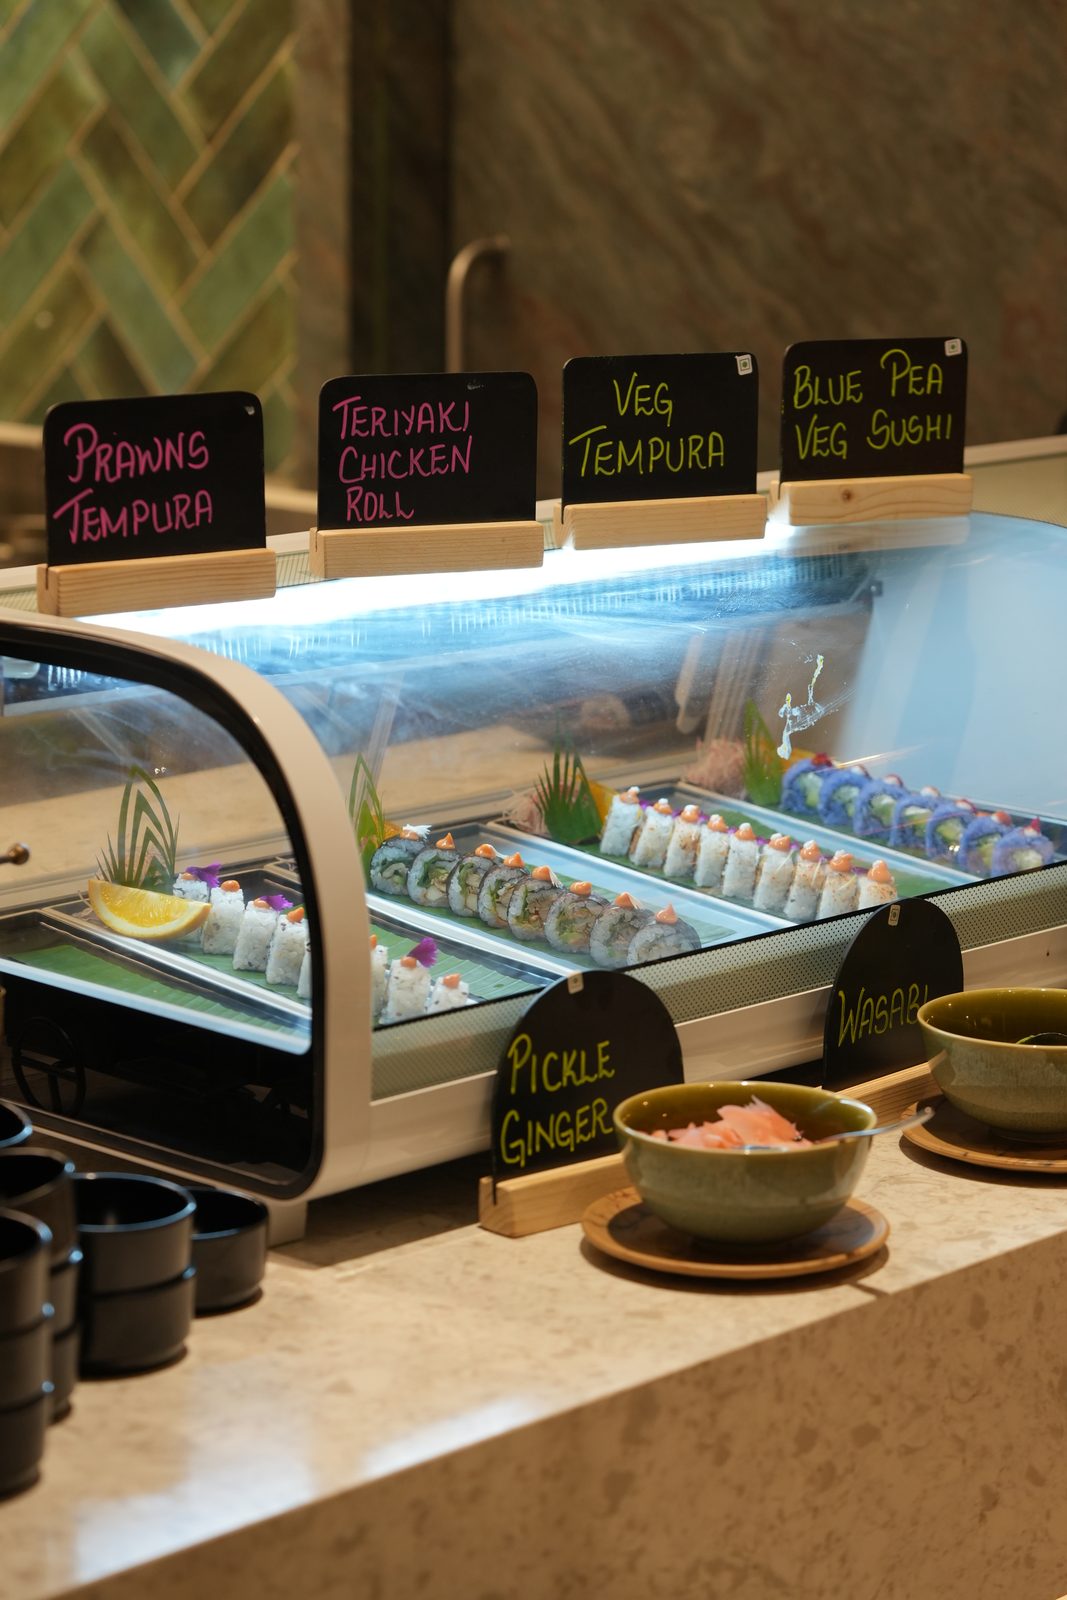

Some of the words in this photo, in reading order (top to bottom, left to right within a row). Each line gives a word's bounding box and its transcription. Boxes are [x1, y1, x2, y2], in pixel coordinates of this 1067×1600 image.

[613, 371, 673, 428] VEG
[793, 365, 863, 409] BLUE
[880, 348, 943, 397] PEA
[332, 395, 472, 442] TERIYAKI
[795, 414, 847, 460] VEG
[866, 408, 952, 450] SUSHI
[63, 422, 209, 483] PRAWNS
[338, 435, 473, 484] CHICKEN
[568, 424, 724, 477] TEMPURA
[53, 487, 213, 545] TEMPURA
[346, 485, 415, 522] ROLL
[507, 1033, 615, 1094] PICKLE
[500, 1097, 614, 1169] GINGER
